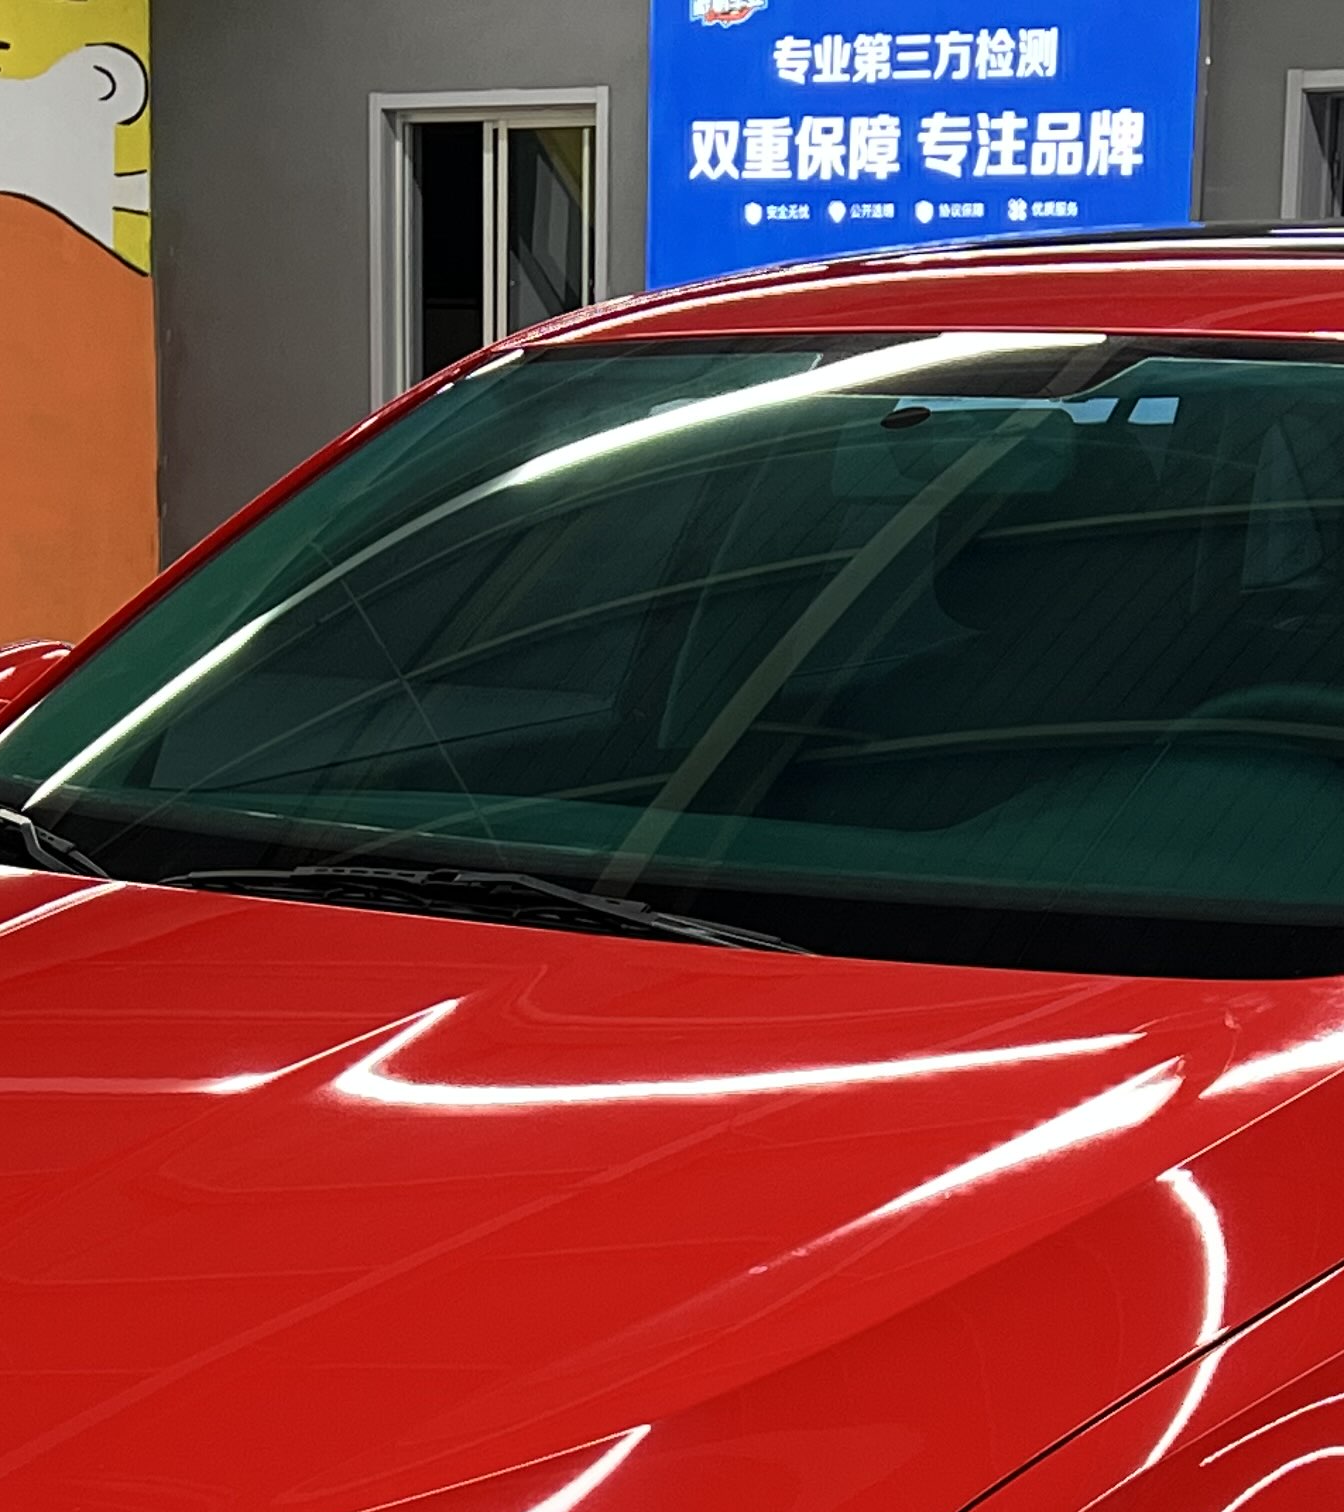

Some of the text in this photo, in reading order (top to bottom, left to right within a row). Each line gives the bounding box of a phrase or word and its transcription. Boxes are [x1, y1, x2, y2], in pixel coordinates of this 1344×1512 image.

[772, 27, 1059, 86] 专业第三方检测
[688, 107, 1145, 181] 双重保障 专注品牌
